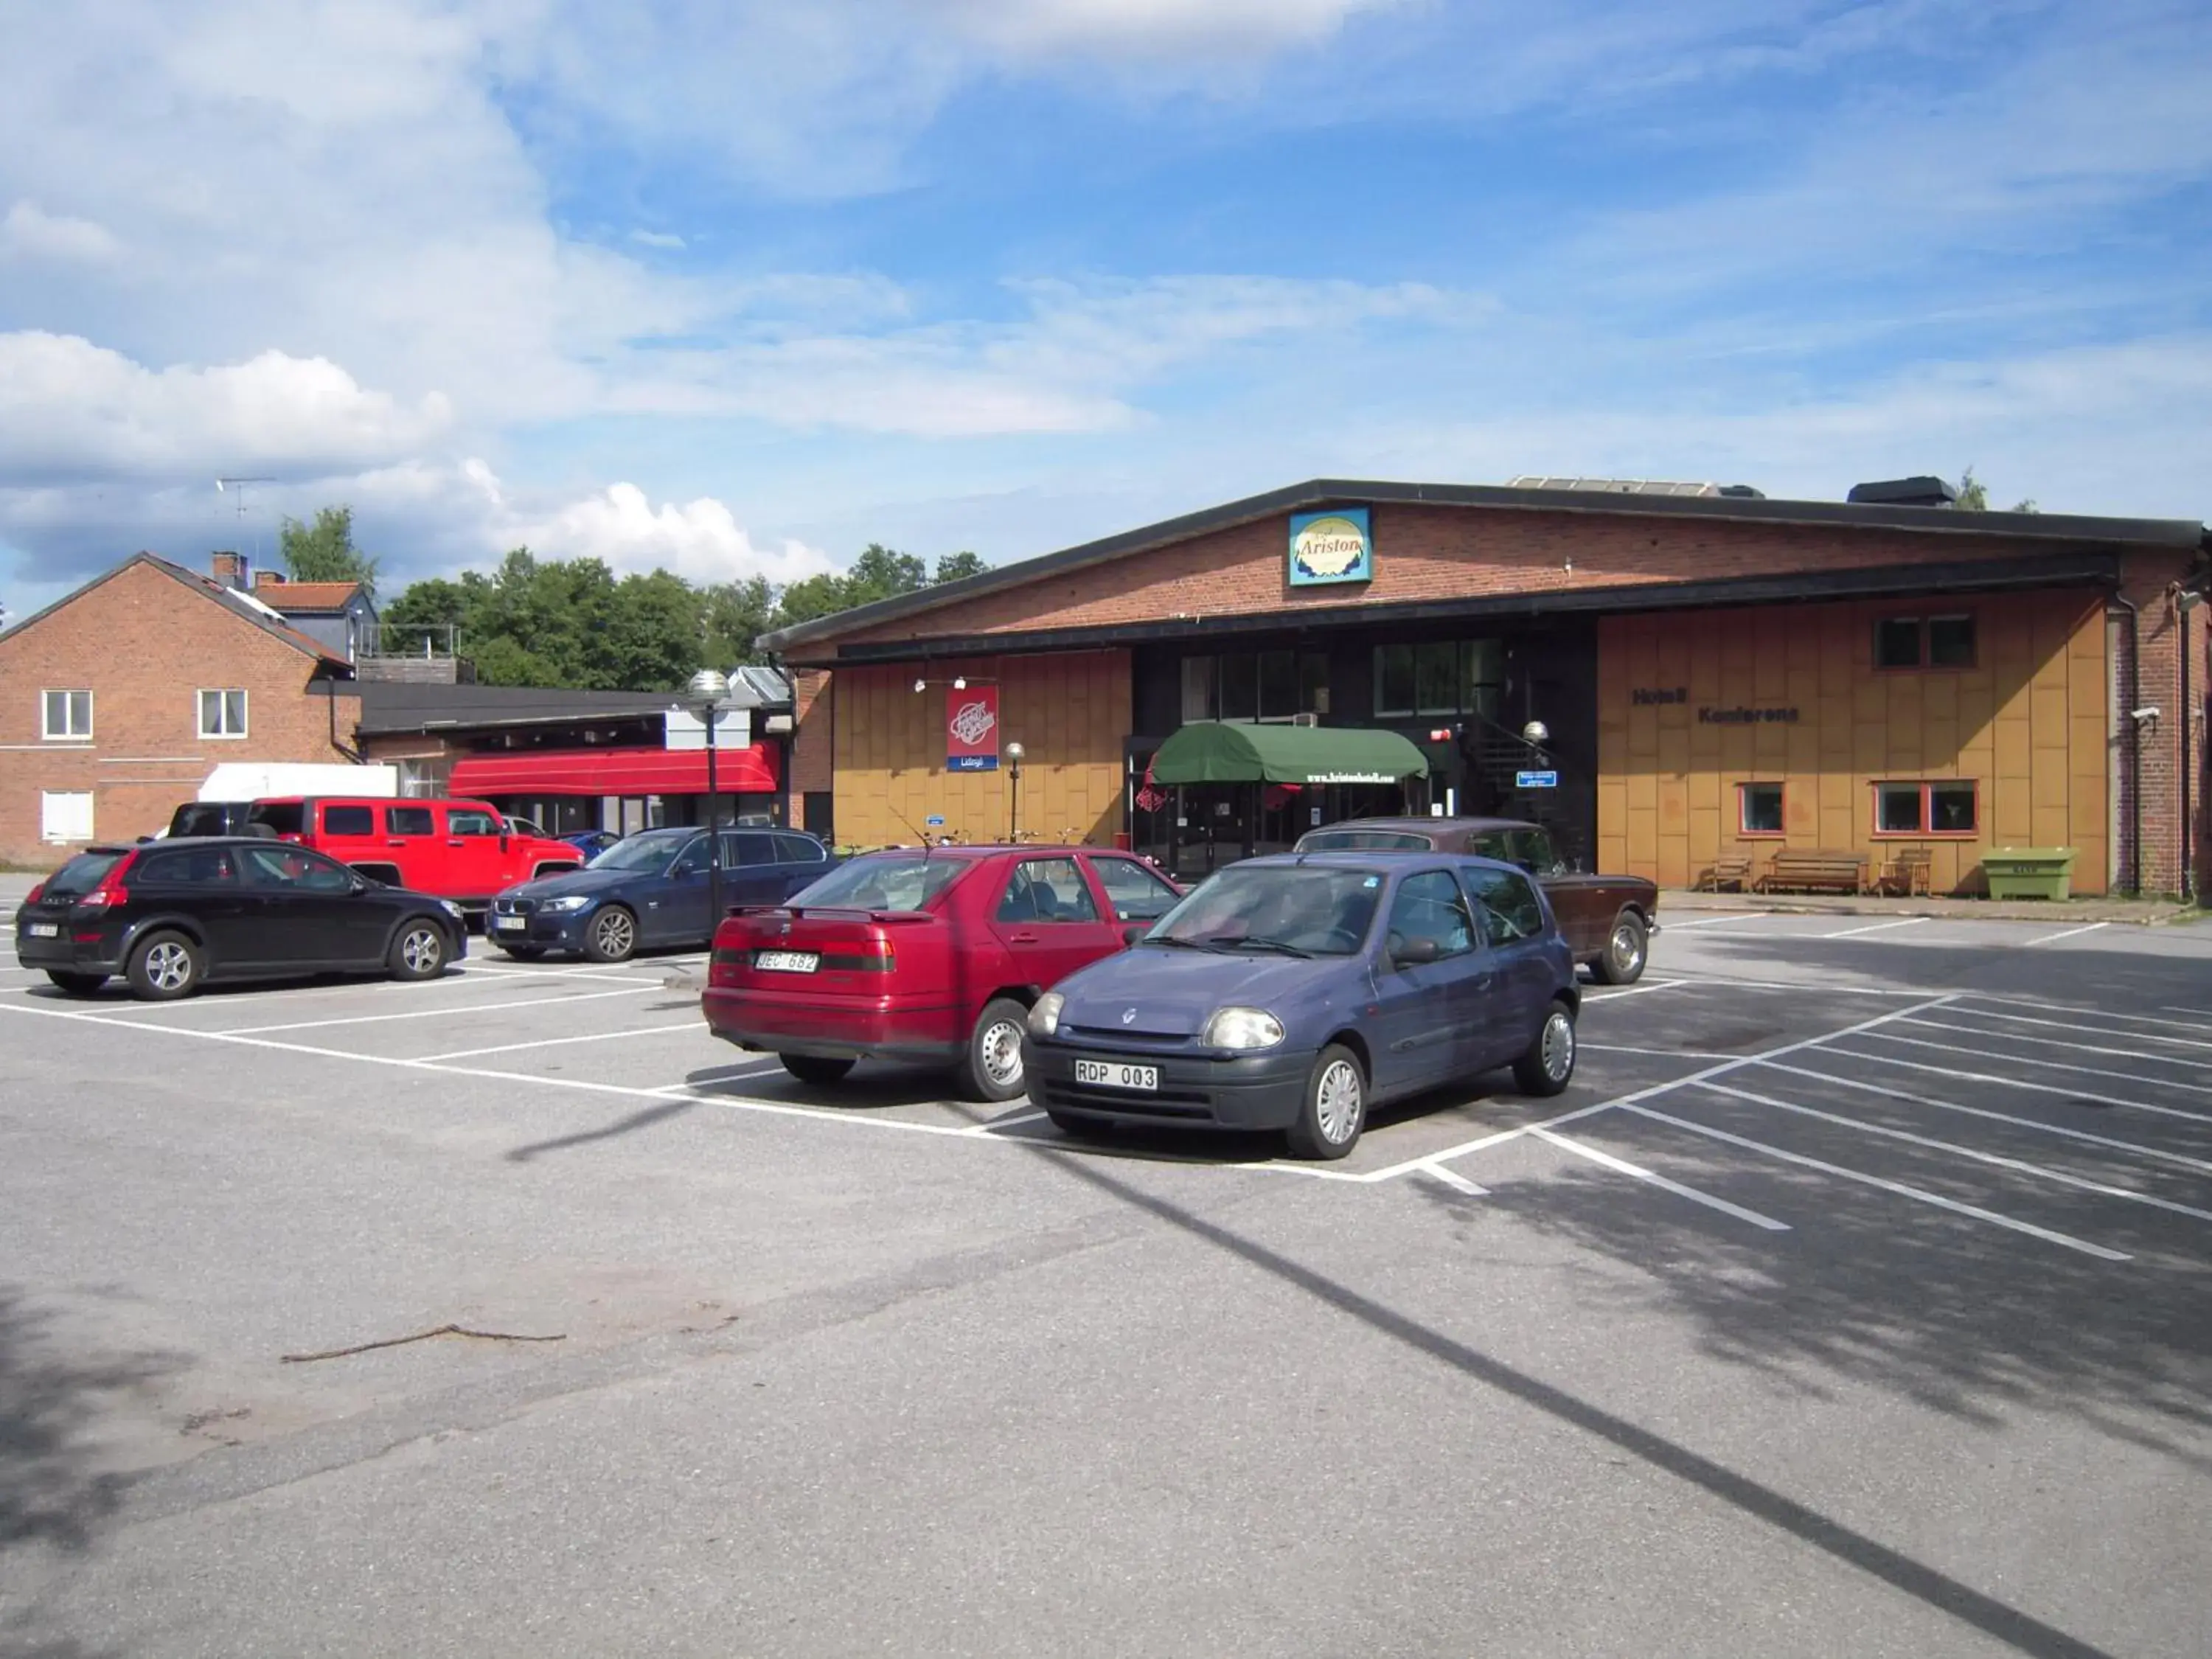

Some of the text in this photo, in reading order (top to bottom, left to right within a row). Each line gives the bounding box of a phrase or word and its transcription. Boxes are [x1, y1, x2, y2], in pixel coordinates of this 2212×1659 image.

[1301, 539, 1360, 555] Ariston
[1078, 1062, 1155, 1086] RDP 003
